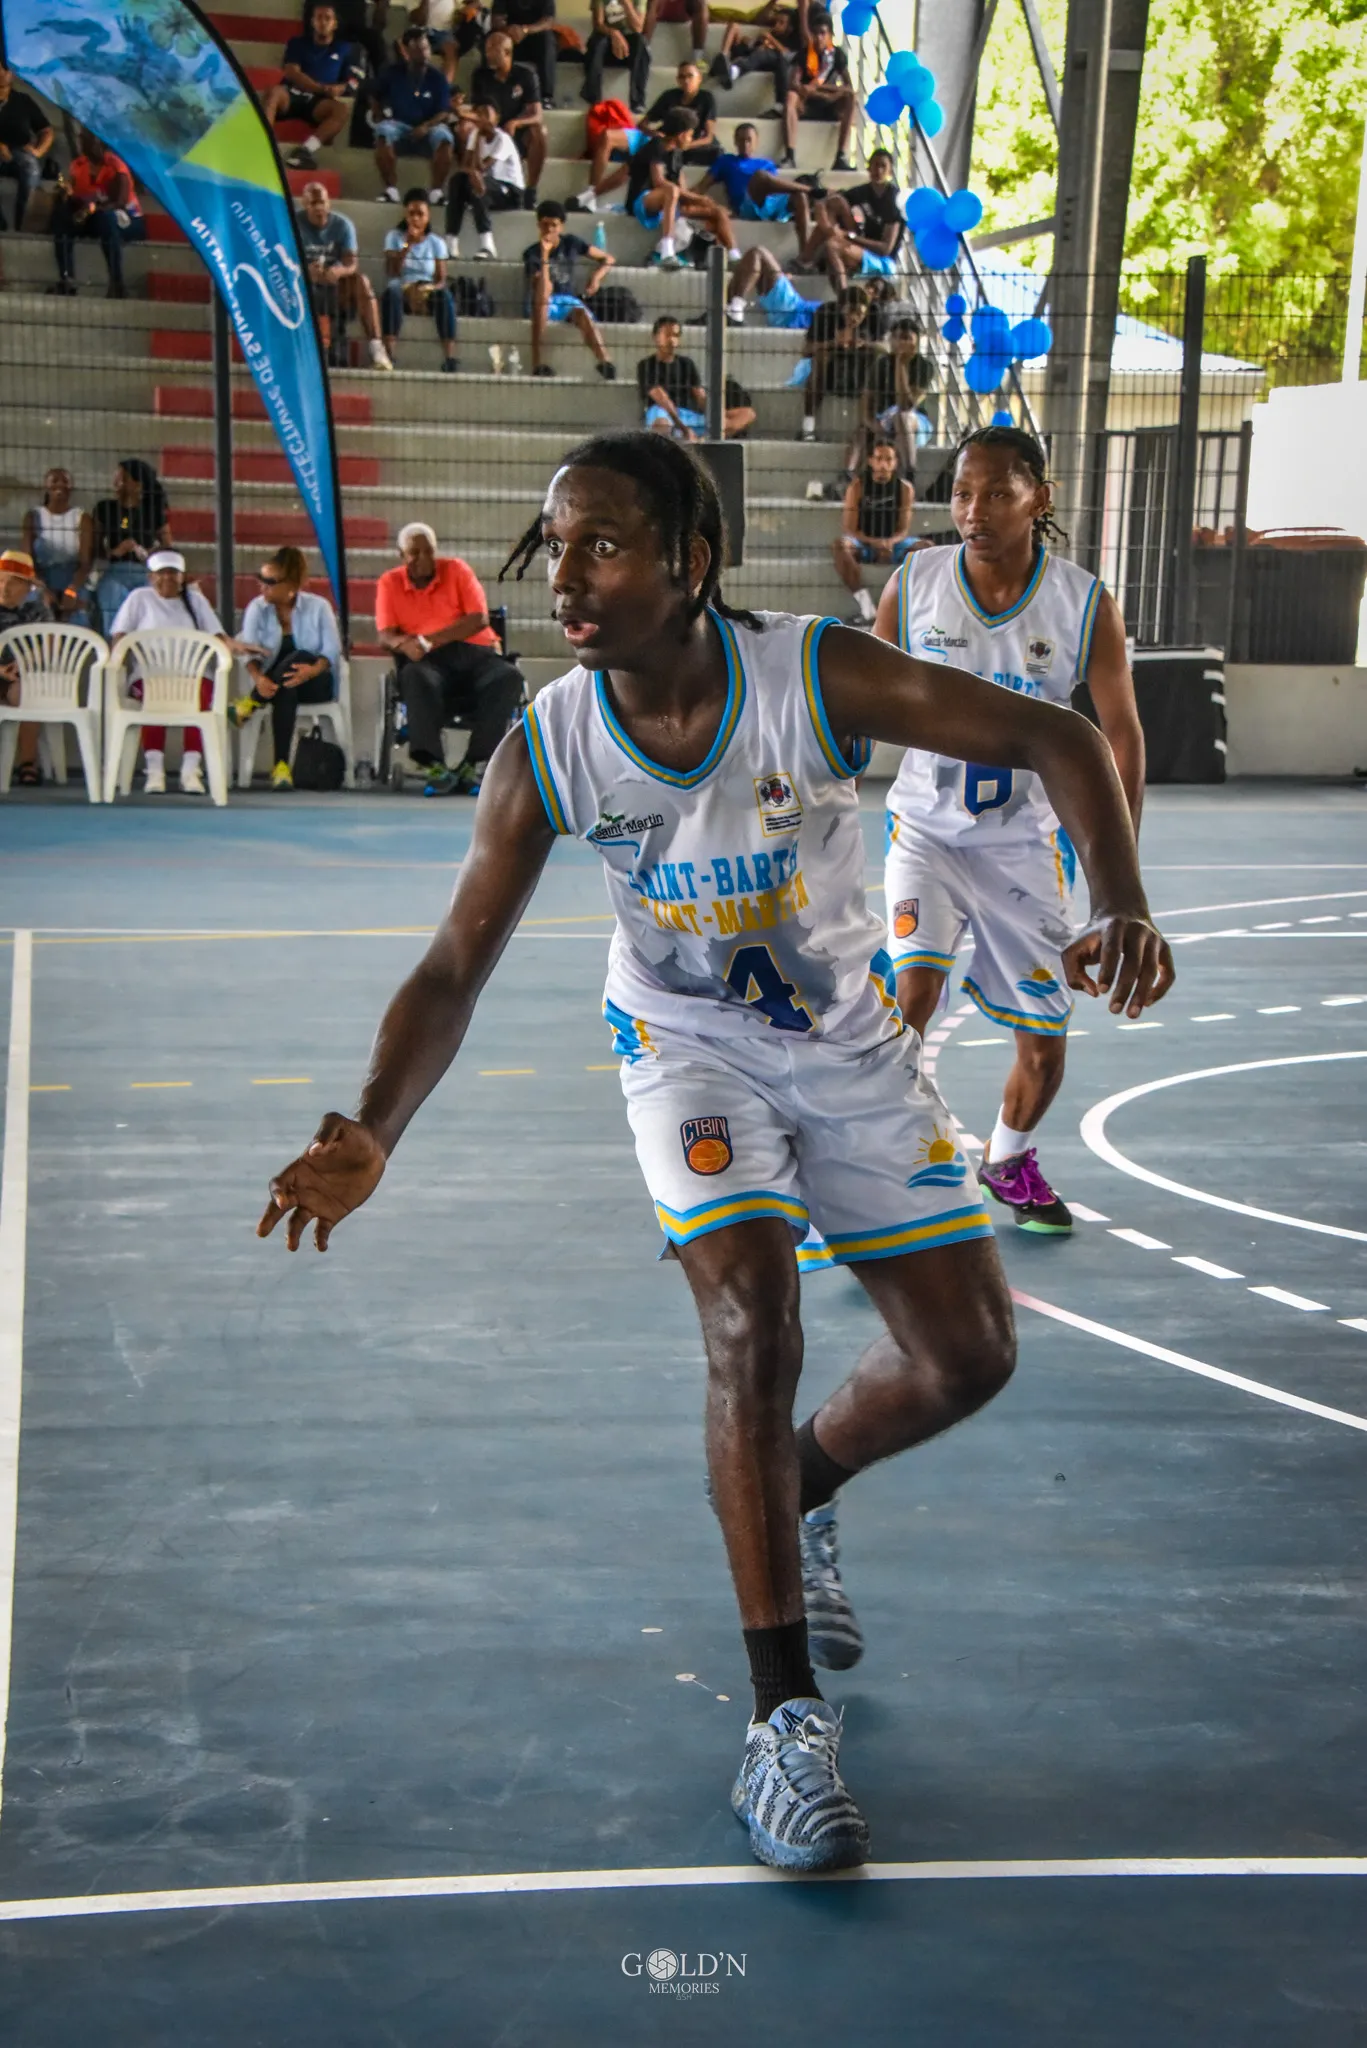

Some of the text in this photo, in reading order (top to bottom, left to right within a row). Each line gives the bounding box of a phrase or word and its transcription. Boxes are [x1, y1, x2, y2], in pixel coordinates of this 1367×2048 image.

[594, 813, 664, 839] Saint-Martin
[722, 942, 816, 1033] 4
[682, 1117, 728, 1147] CTBIN
